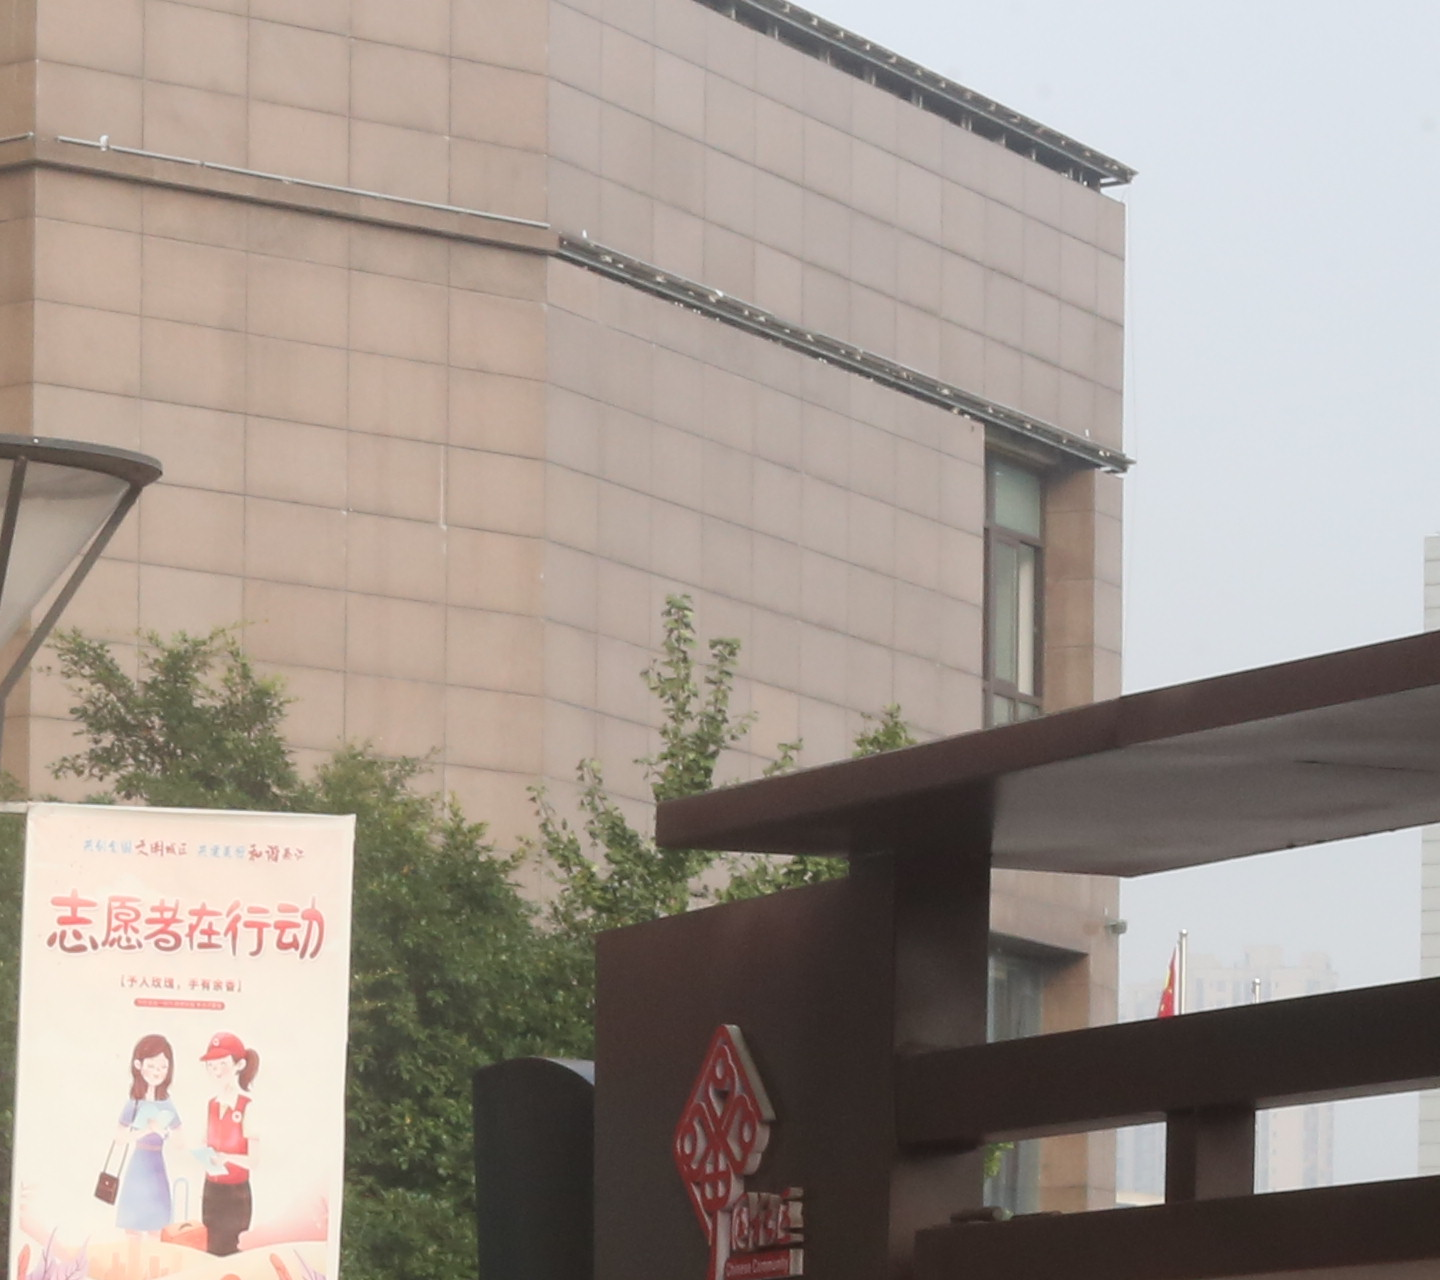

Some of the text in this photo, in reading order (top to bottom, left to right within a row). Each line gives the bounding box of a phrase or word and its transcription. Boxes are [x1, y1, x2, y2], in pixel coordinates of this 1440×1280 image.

[46, 886, 326, 961] 志愿者在行动
